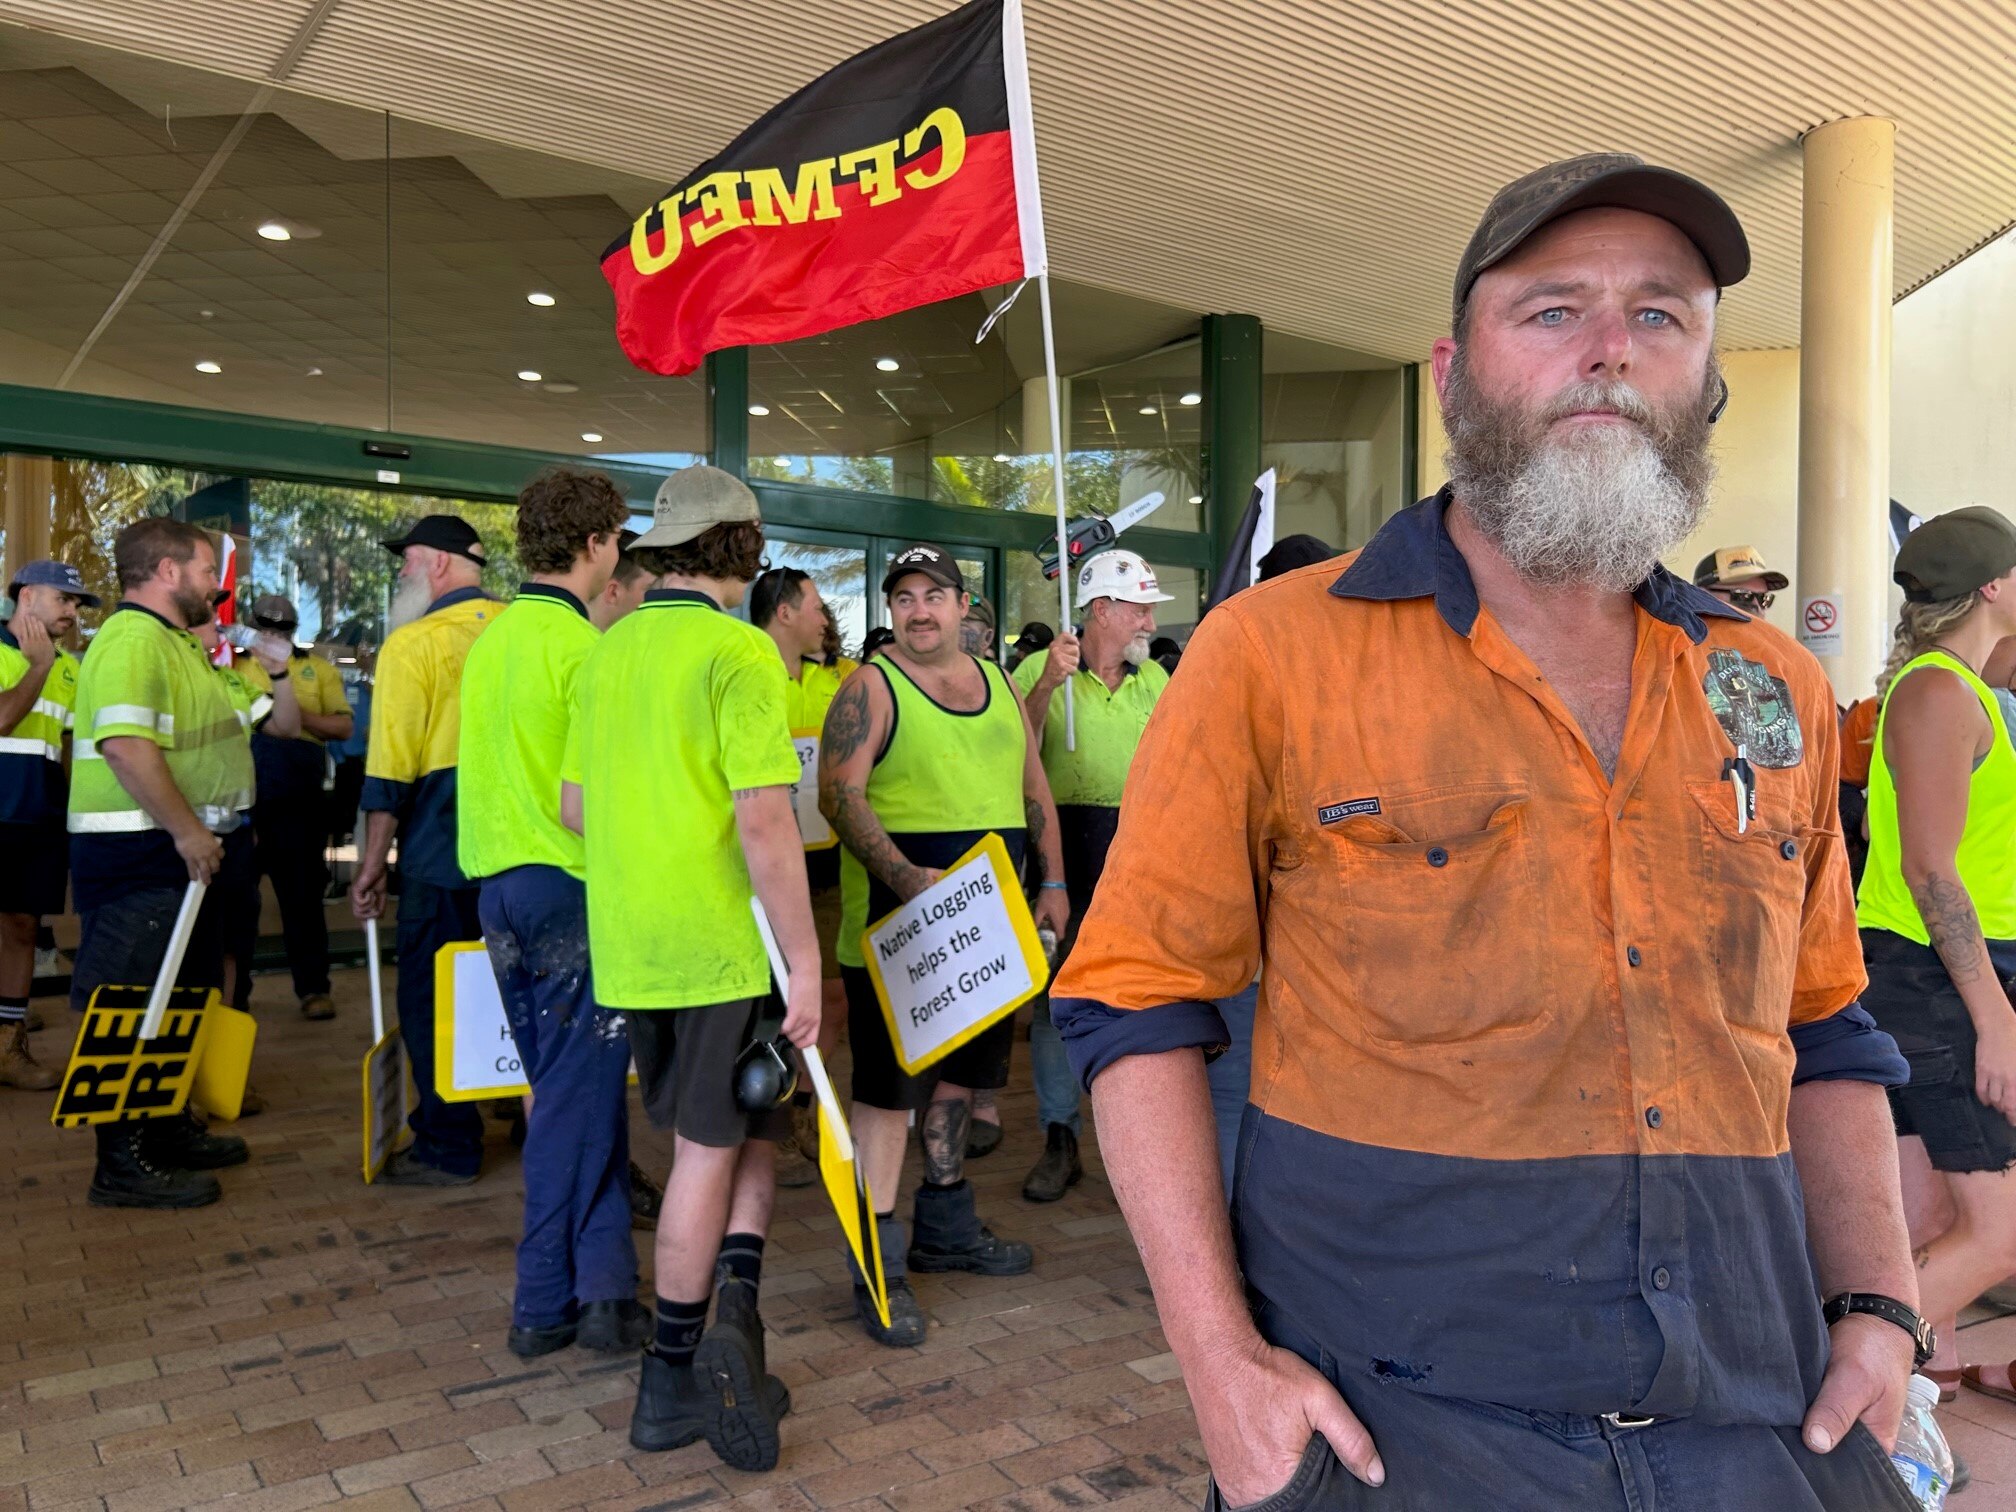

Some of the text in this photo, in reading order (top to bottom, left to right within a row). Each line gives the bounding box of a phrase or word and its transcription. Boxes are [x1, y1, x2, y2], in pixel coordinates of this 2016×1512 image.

[1349, 803, 1375, 812] wear
[879, 872, 993, 961] Native Logging
[907, 925, 982, 984] helps the
[910, 953, 1007, 1028] Forest Grow
